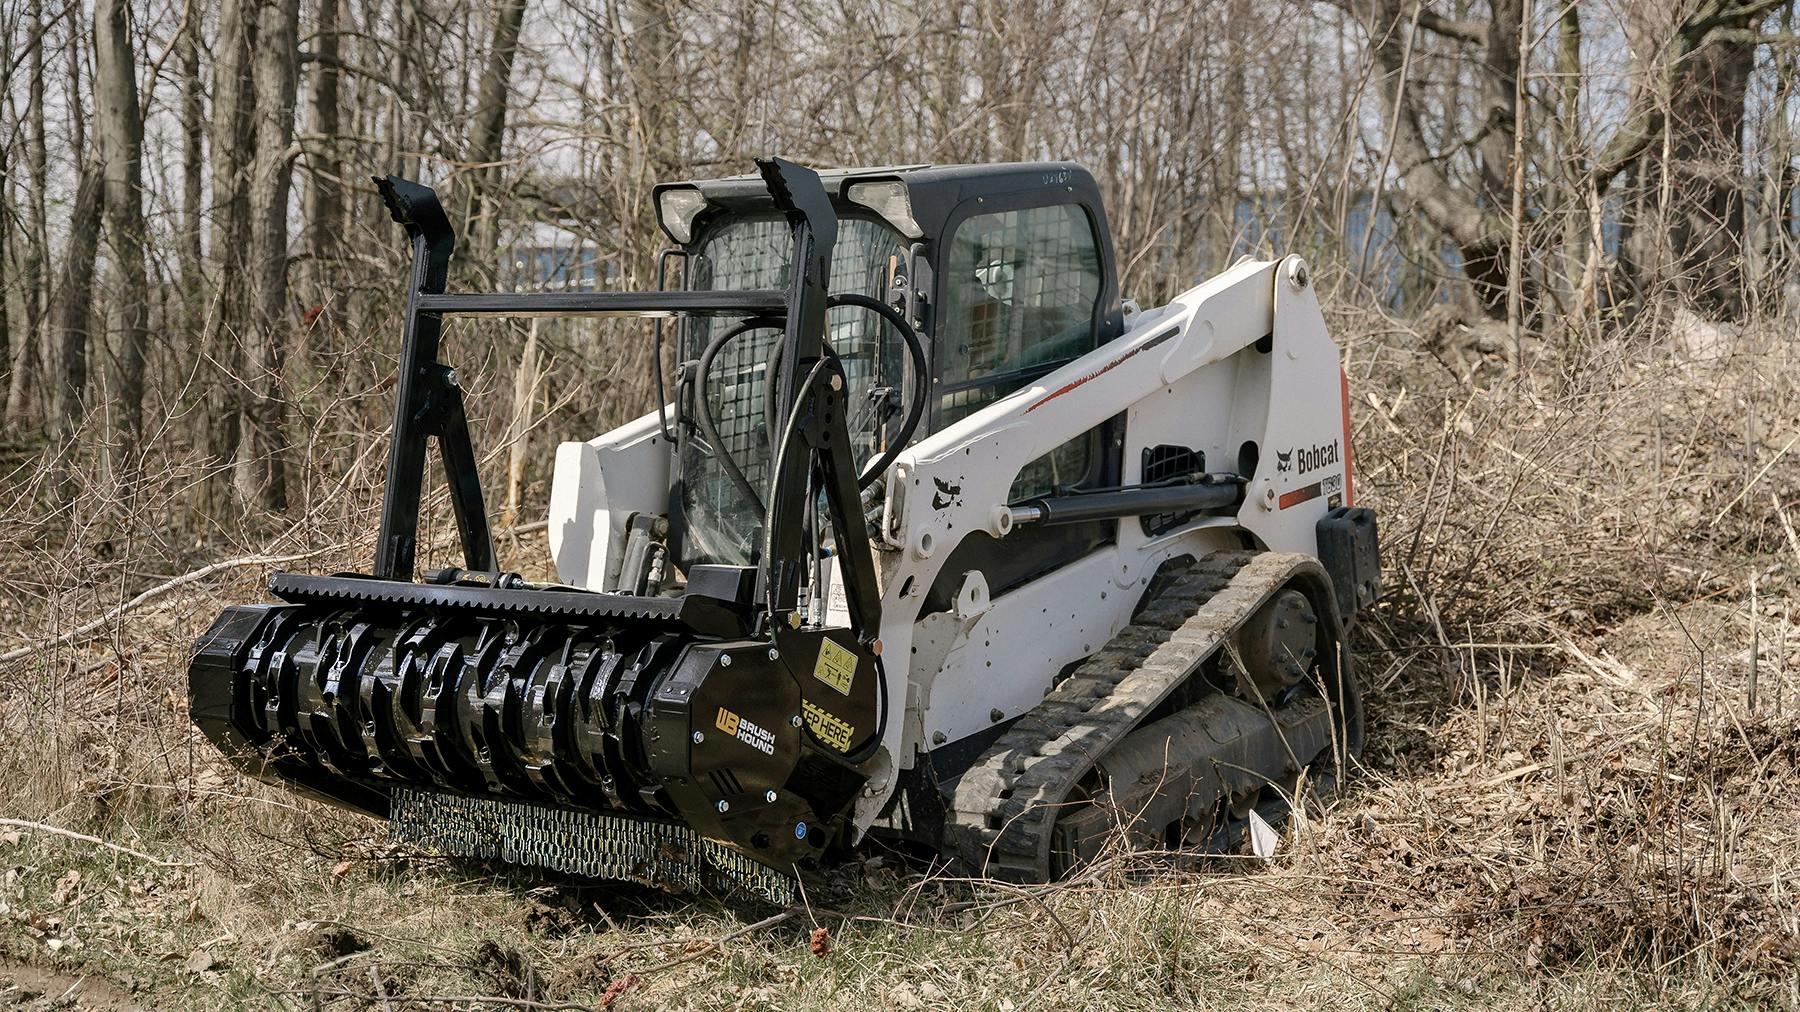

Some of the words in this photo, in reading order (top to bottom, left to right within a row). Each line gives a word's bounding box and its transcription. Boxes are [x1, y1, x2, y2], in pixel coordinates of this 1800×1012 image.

[1298, 438, 1339, 475] Bobcat
[736, 729, 775, 756] HOUND
[739, 718, 776, 744] BRUSH
[820, 717, 849, 744] HERE
